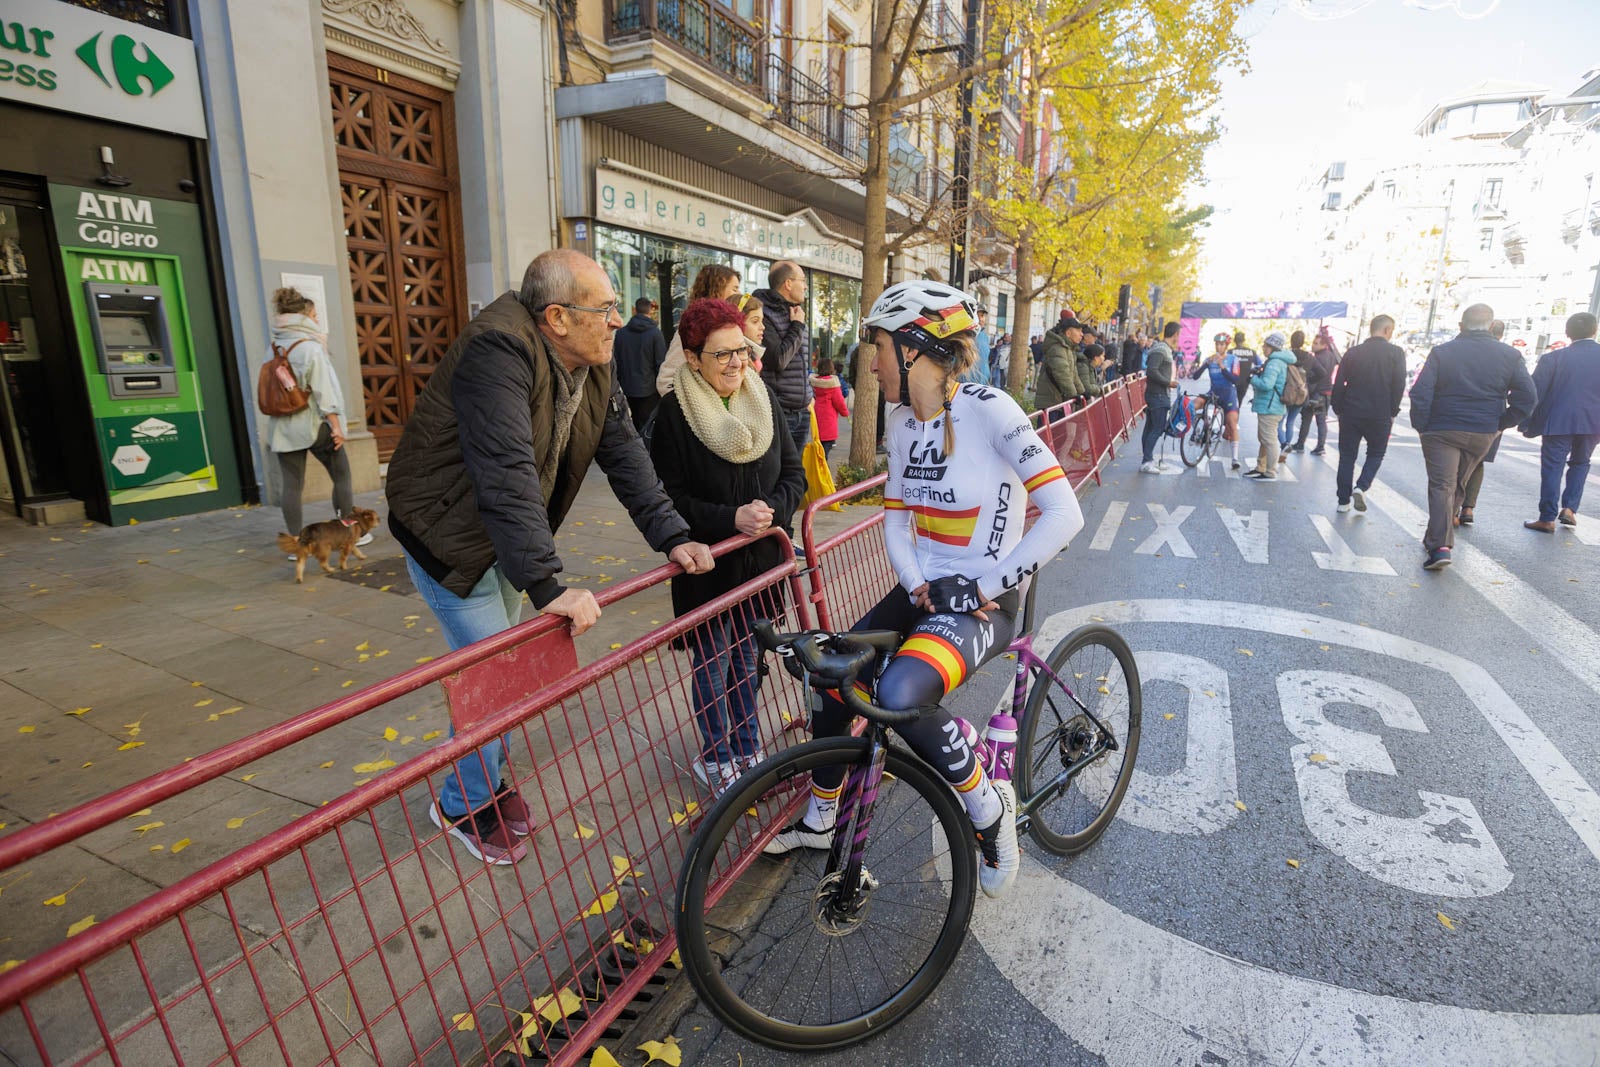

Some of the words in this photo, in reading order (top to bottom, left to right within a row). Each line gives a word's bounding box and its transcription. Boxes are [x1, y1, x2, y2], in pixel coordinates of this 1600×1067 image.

[78, 191, 154, 225] ATM
[602, 185, 706, 227] galería
[722, 216, 745, 235] de
[759, 229, 794, 249] arte
[78, 222, 159, 249] Cajero
[81, 257, 148, 283] ATM
[909, 440, 948, 465] Liv
[908, 468, 938, 479] RACING
[901, 484, 956, 504] TeqFind
[984, 482, 1011, 561] CADEX
[1089, 501, 1398, 576] TAXI
[1001, 562, 1038, 590] Liv
[949, 593, 979, 612] Liv
[973, 623, 994, 667] Liv
[941, 720, 970, 771] Liv
[1079, 651, 1514, 898] 30
